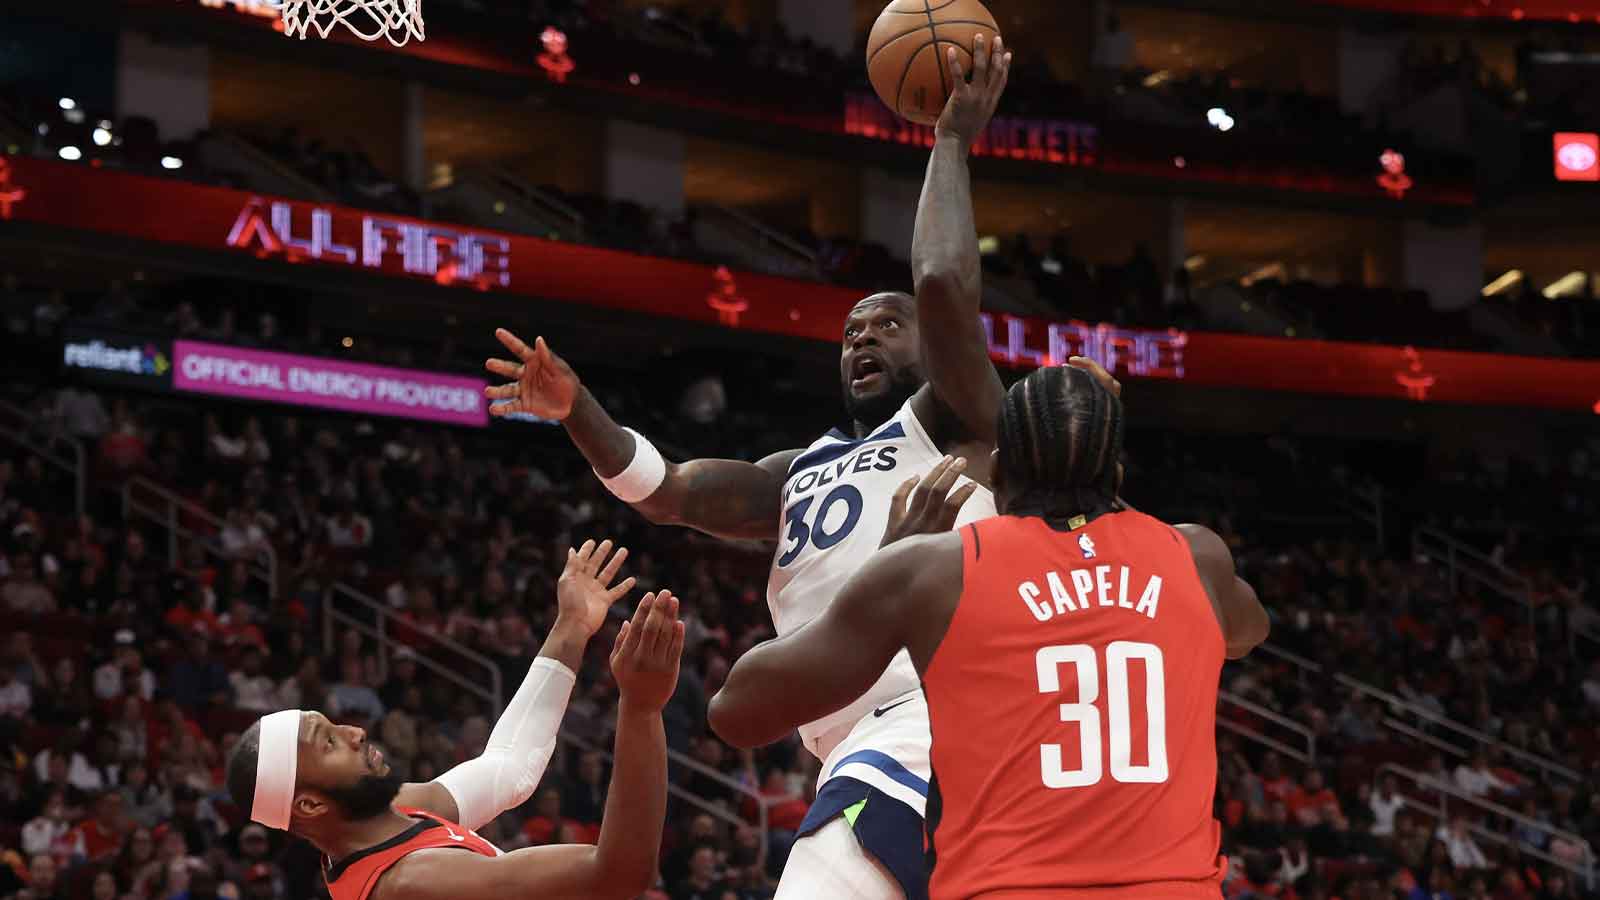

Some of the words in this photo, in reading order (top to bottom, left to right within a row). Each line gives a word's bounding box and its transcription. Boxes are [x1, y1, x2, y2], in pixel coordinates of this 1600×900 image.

[63, 340, 144, 374] reliant
[982, 311, 1045, 368] LL
[181, 353, 285, 391] OFFICIAL
[287, 364, 373, 400] ENERGY
[374, 376, 481, 413] PROVIDER
[777, 484, 864, 568] 30
[1017, 564, 1163, 622] CAPELA
[1035, 640, 1170, 789] 30
